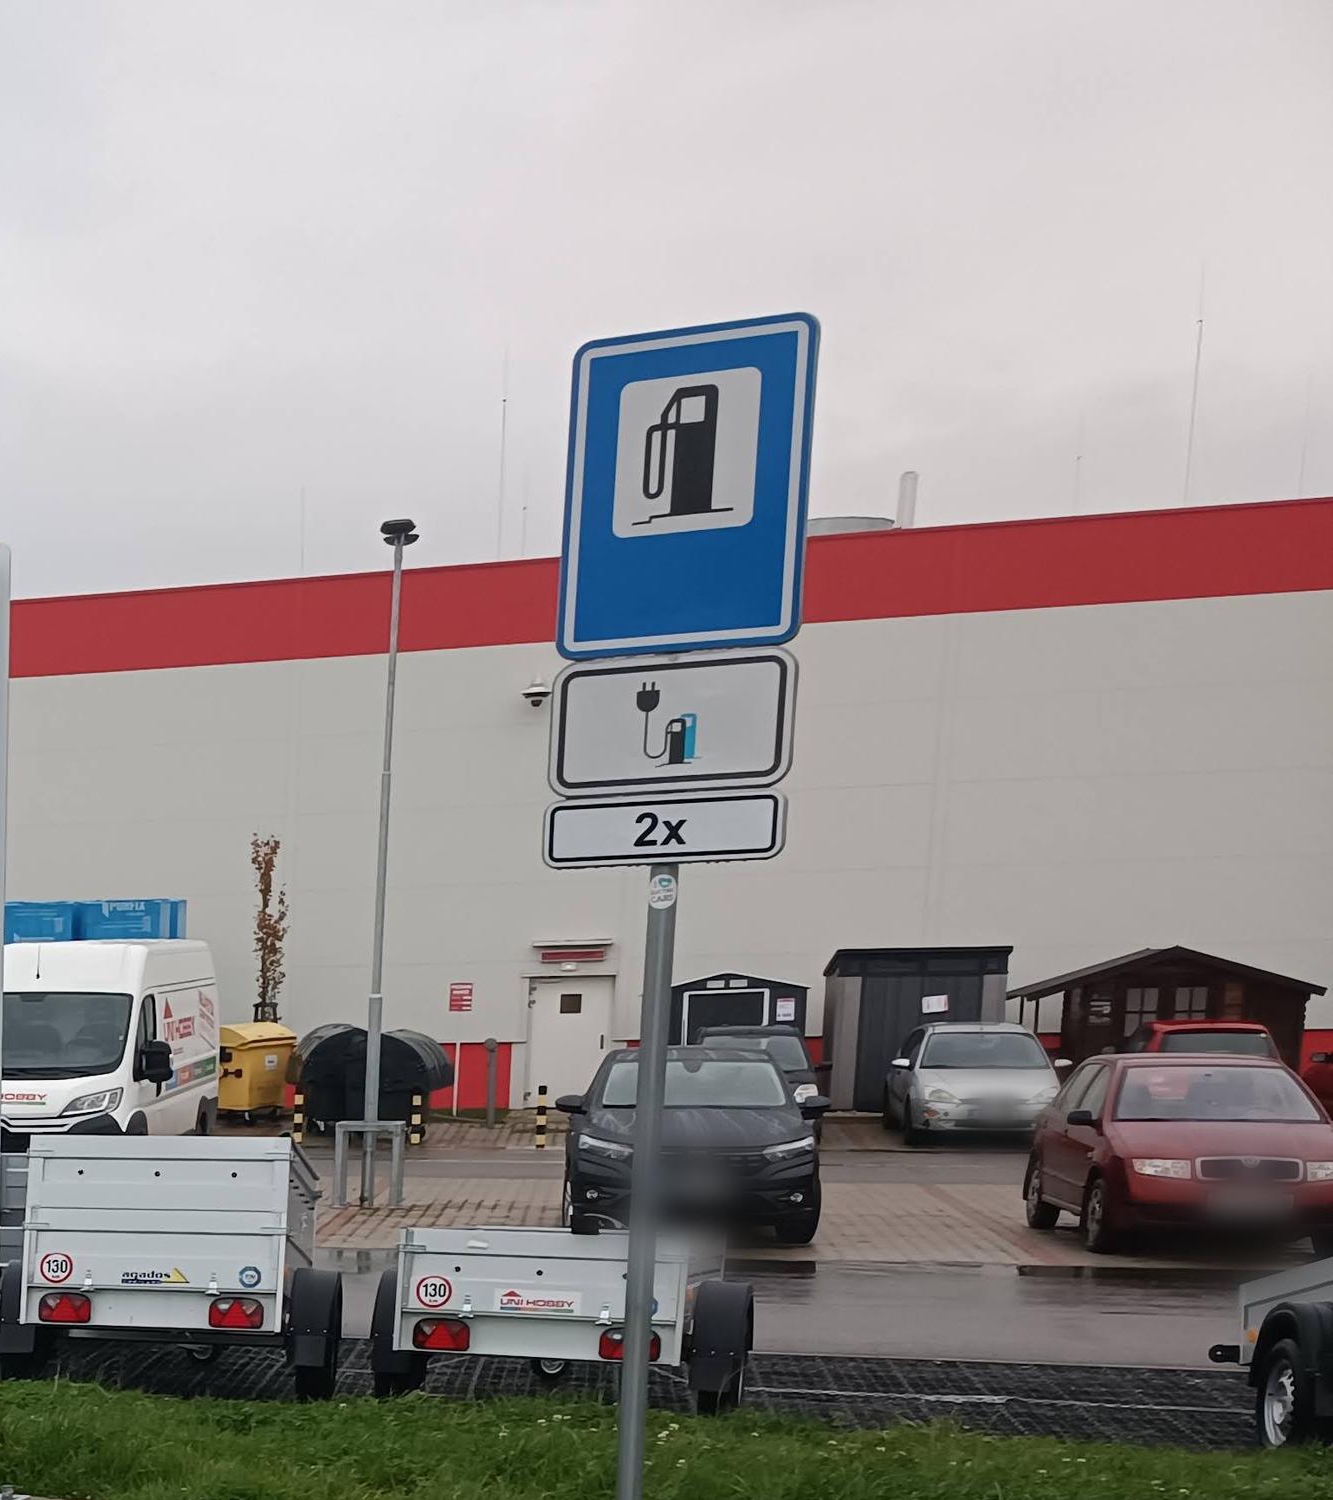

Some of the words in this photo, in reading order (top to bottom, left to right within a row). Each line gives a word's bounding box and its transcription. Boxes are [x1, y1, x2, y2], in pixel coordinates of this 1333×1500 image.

[633, 812, 687, 847] 2x
[45, 1259, 68, 1273] 130
[422, 1283, 447, 1298] 130
[500, 1298, 524, 1306] UNI
[526, 1299, 575, 1308] HOBBY
